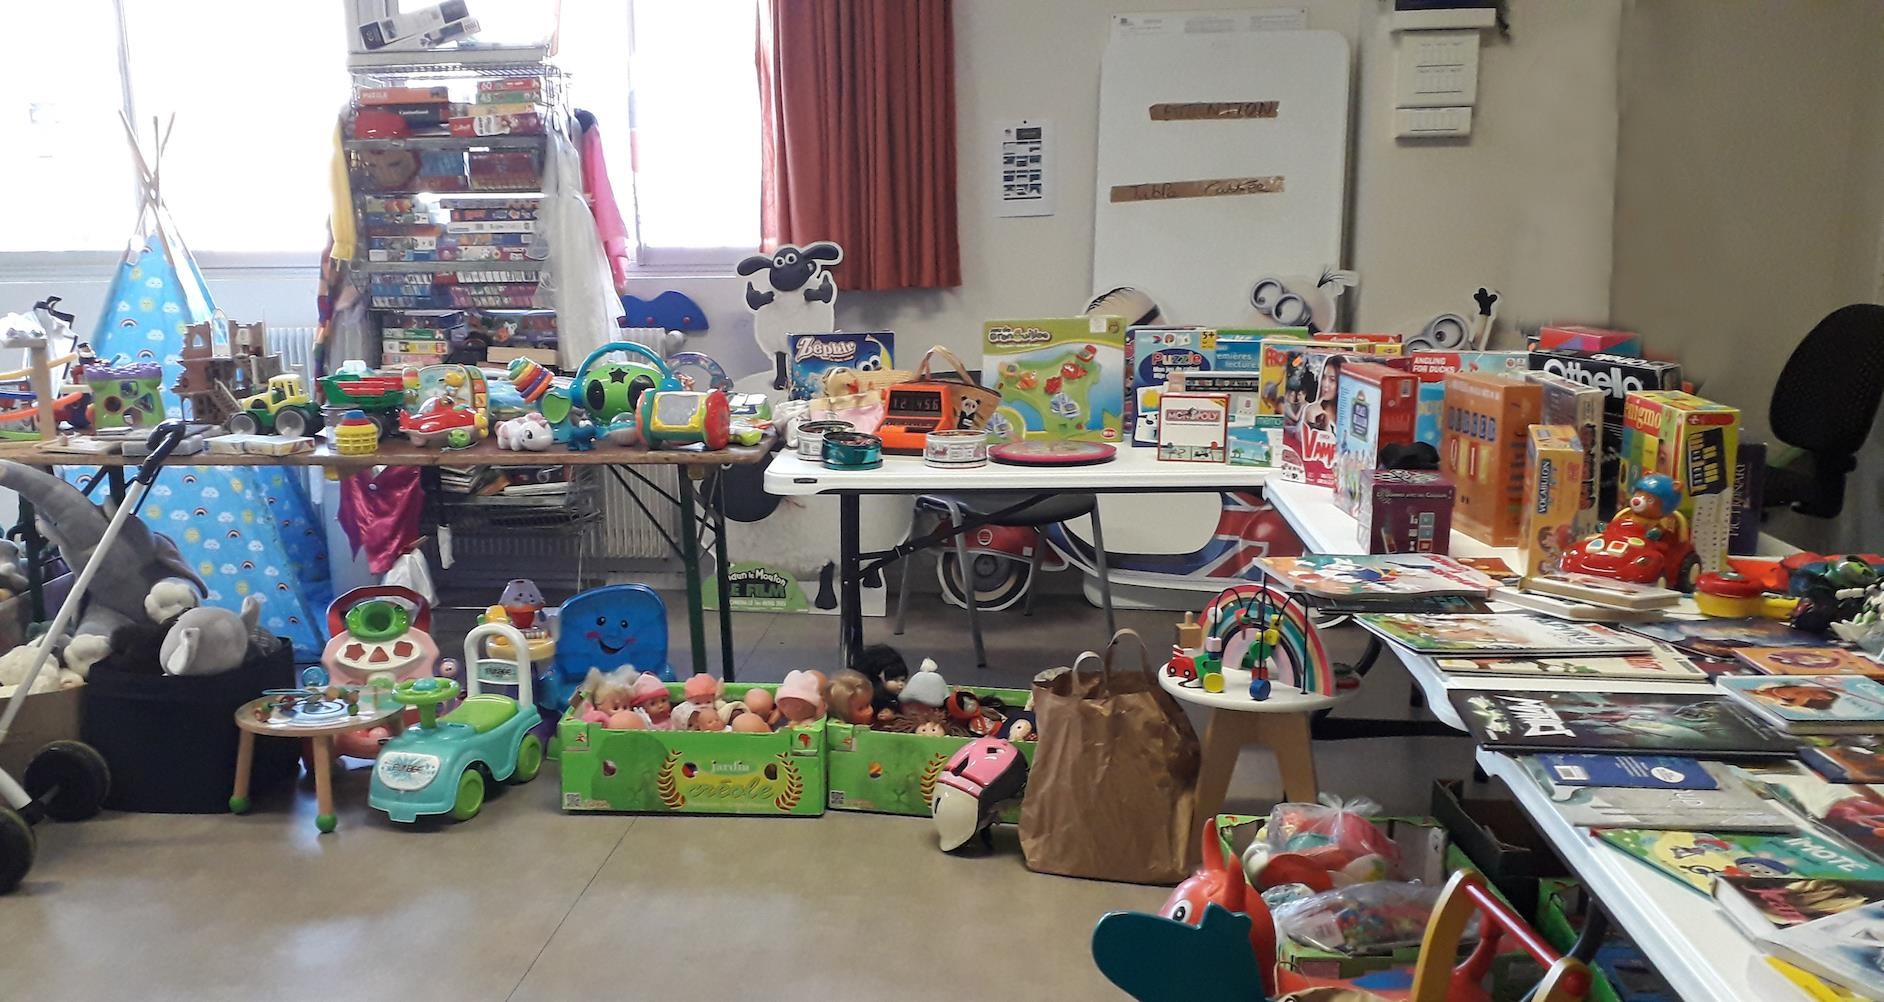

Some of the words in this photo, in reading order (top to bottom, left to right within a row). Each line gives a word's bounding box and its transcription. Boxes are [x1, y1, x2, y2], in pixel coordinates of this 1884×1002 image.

[1152, 351, 1202, 366] Puzzle
[1413, 357, 1447, 365] ANGLING
[1413, 365, 1428, 373] FOR
[1430, 366, 1456, 374] DUCKS
[1544, 358, 1643, 398] Othello
[1539, 459, 1551, 514] VOCABULON
[755, 568, 786, 586] Mouton
[746, 583, 785, 597] FILM
[711, 759, 750, 773] jardin
